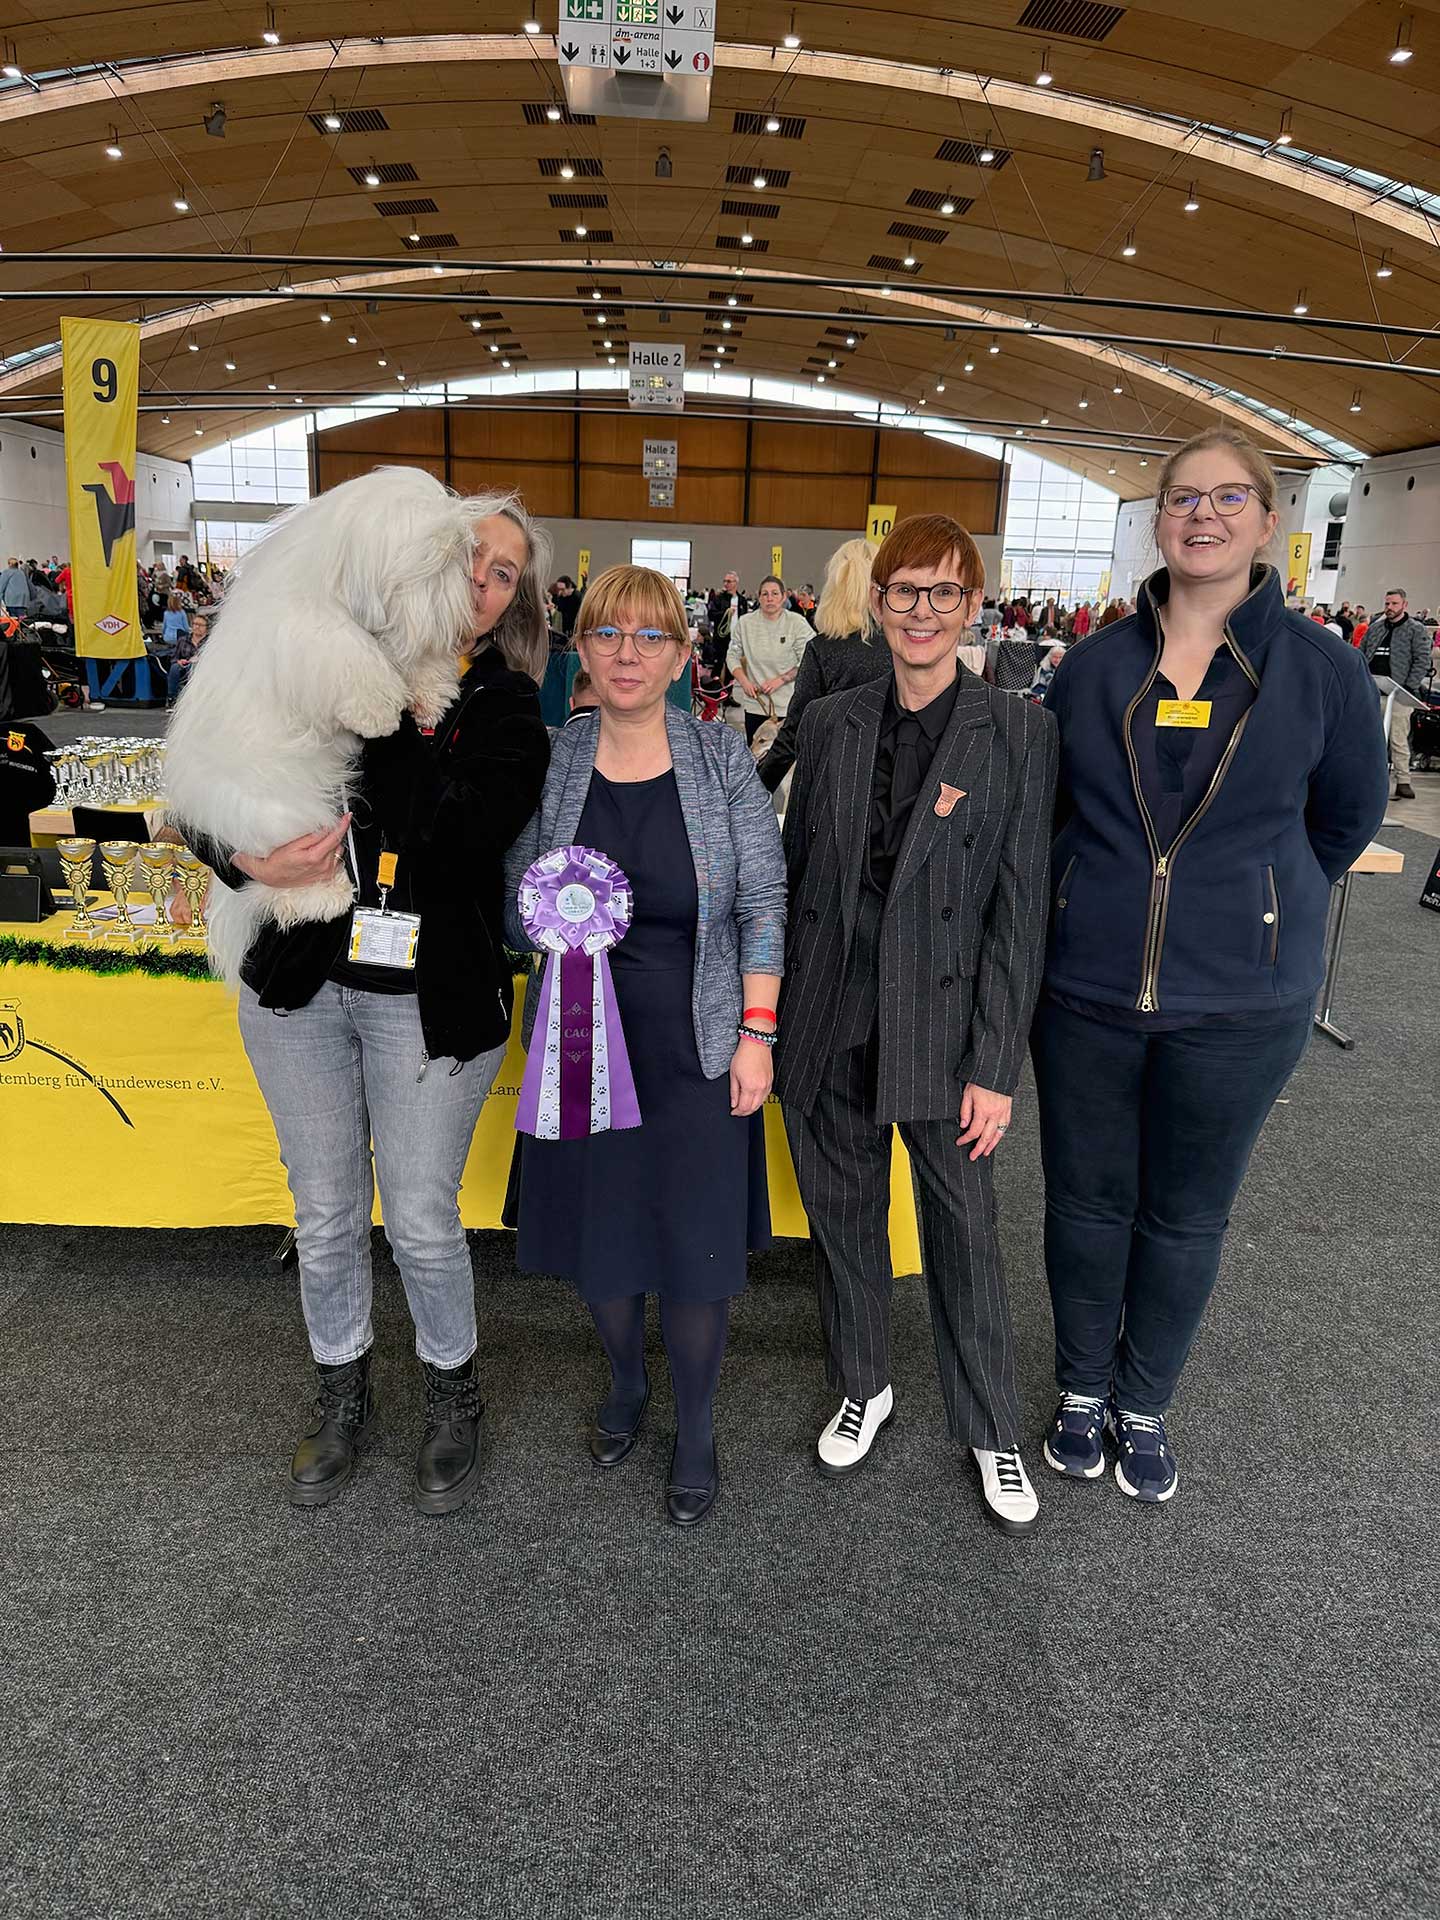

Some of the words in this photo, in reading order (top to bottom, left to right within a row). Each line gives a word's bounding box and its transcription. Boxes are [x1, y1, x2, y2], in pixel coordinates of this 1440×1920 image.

[615, 28, 660, 41] dm-arena
[636, 47, 660, 58] Halle
[640, 59, 656, 69] 1+3
[632, 351, 669, 366] Halle
[673, 353, 682, 366] 2
[92, 358, 117, 403] 9
[645, 445, 668, 454] Halle
[670, 446, 676, 454] 2
[872, 519, 892, 537] 10
[102, 621, 120, 629] VDH
[564, 1027, 589, 1039] CAC
[65, 1073, 87, 1087] für
[93, 1075, 192, 1090] Hundewesen
[196, 1077, 225, 1091] e.V.
